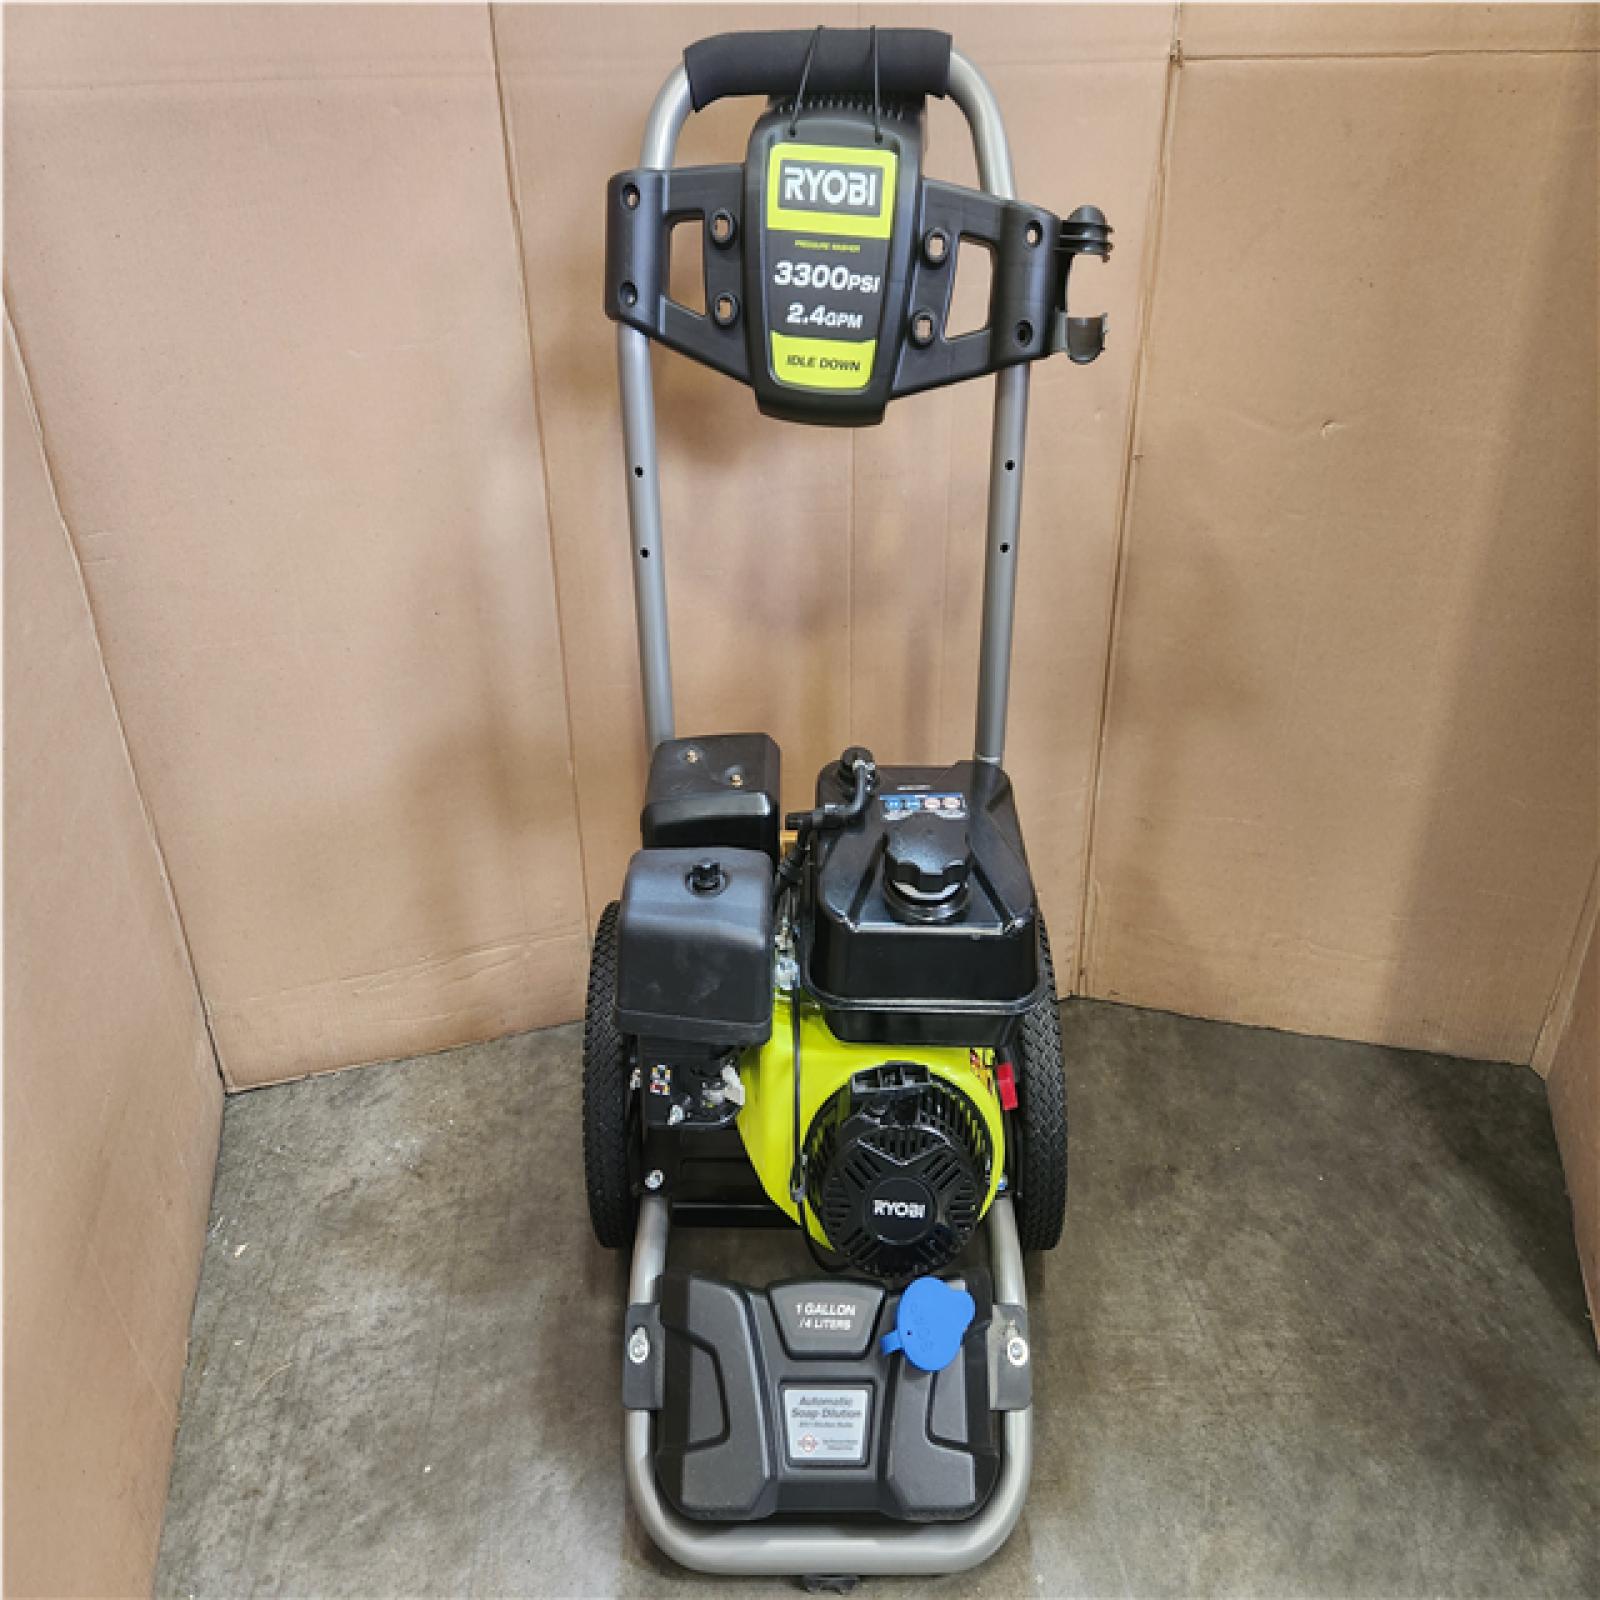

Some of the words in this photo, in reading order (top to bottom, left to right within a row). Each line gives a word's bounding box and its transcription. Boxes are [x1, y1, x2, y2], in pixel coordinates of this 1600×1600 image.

[784, 166, 876, 206] RYOBI
[774, 260, 880, 293] 3300PSI
[786, 302, 863, 329] 2.4GPM
[787, 354, 816, 369] IDLE
[819, 357, 861, 371] DOWN
[873, 1199, 926, 1218] RYOBI
[795, 1303, 802, 1316] 1
[804, 1302, 856, 1316] GALLON
[814, 1318, 851, 1331] LITERS
[791, 1407, 819, 1420] Soap
